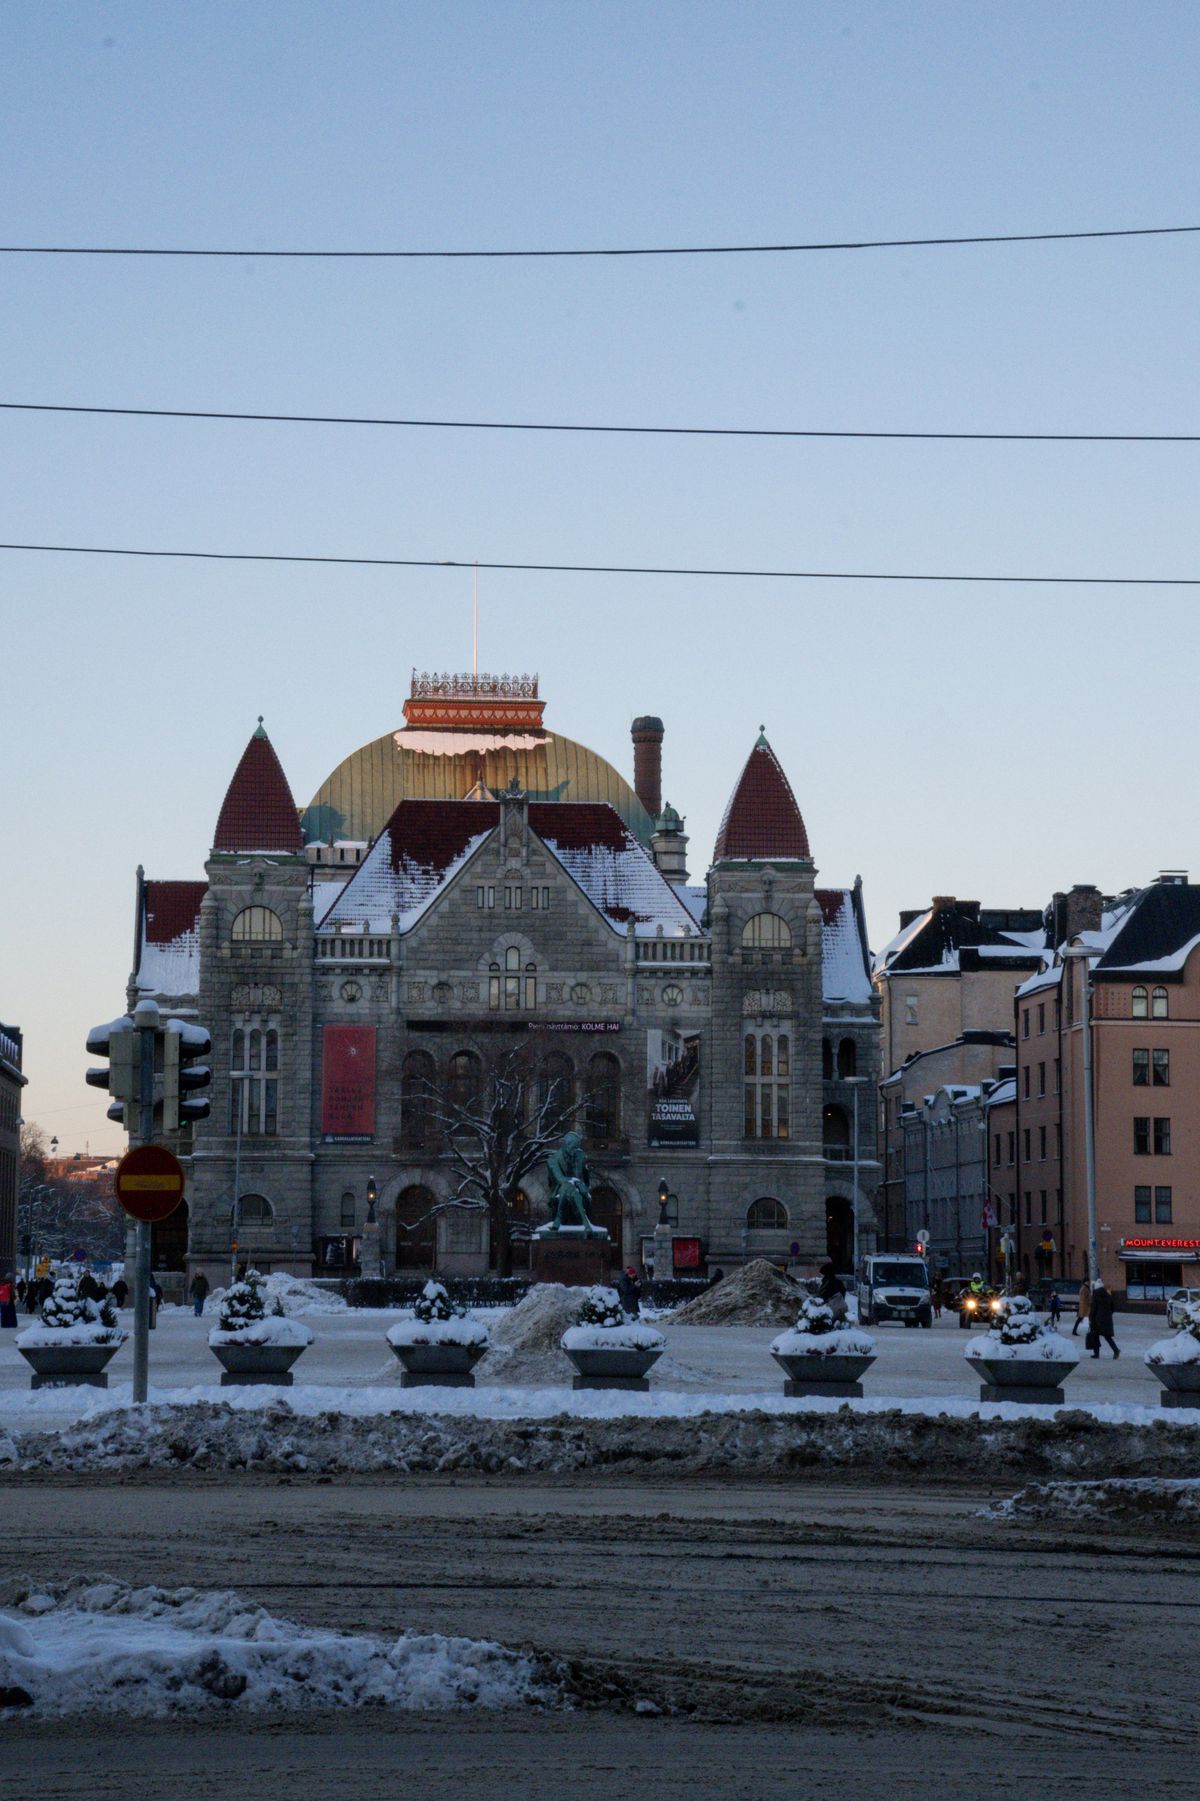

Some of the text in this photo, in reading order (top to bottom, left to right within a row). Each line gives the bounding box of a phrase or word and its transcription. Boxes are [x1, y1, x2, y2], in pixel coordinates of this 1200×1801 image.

[581, 1022, 605, 1031] KOLME
[607, 1023, 619, 1031] HAI
[655, 1104, 692, 1113] TOINEN
[651, 1112, 695, 1121] TASAVALTA
[1126, 1239, 1200, 1247] MOUNT EVEREST
